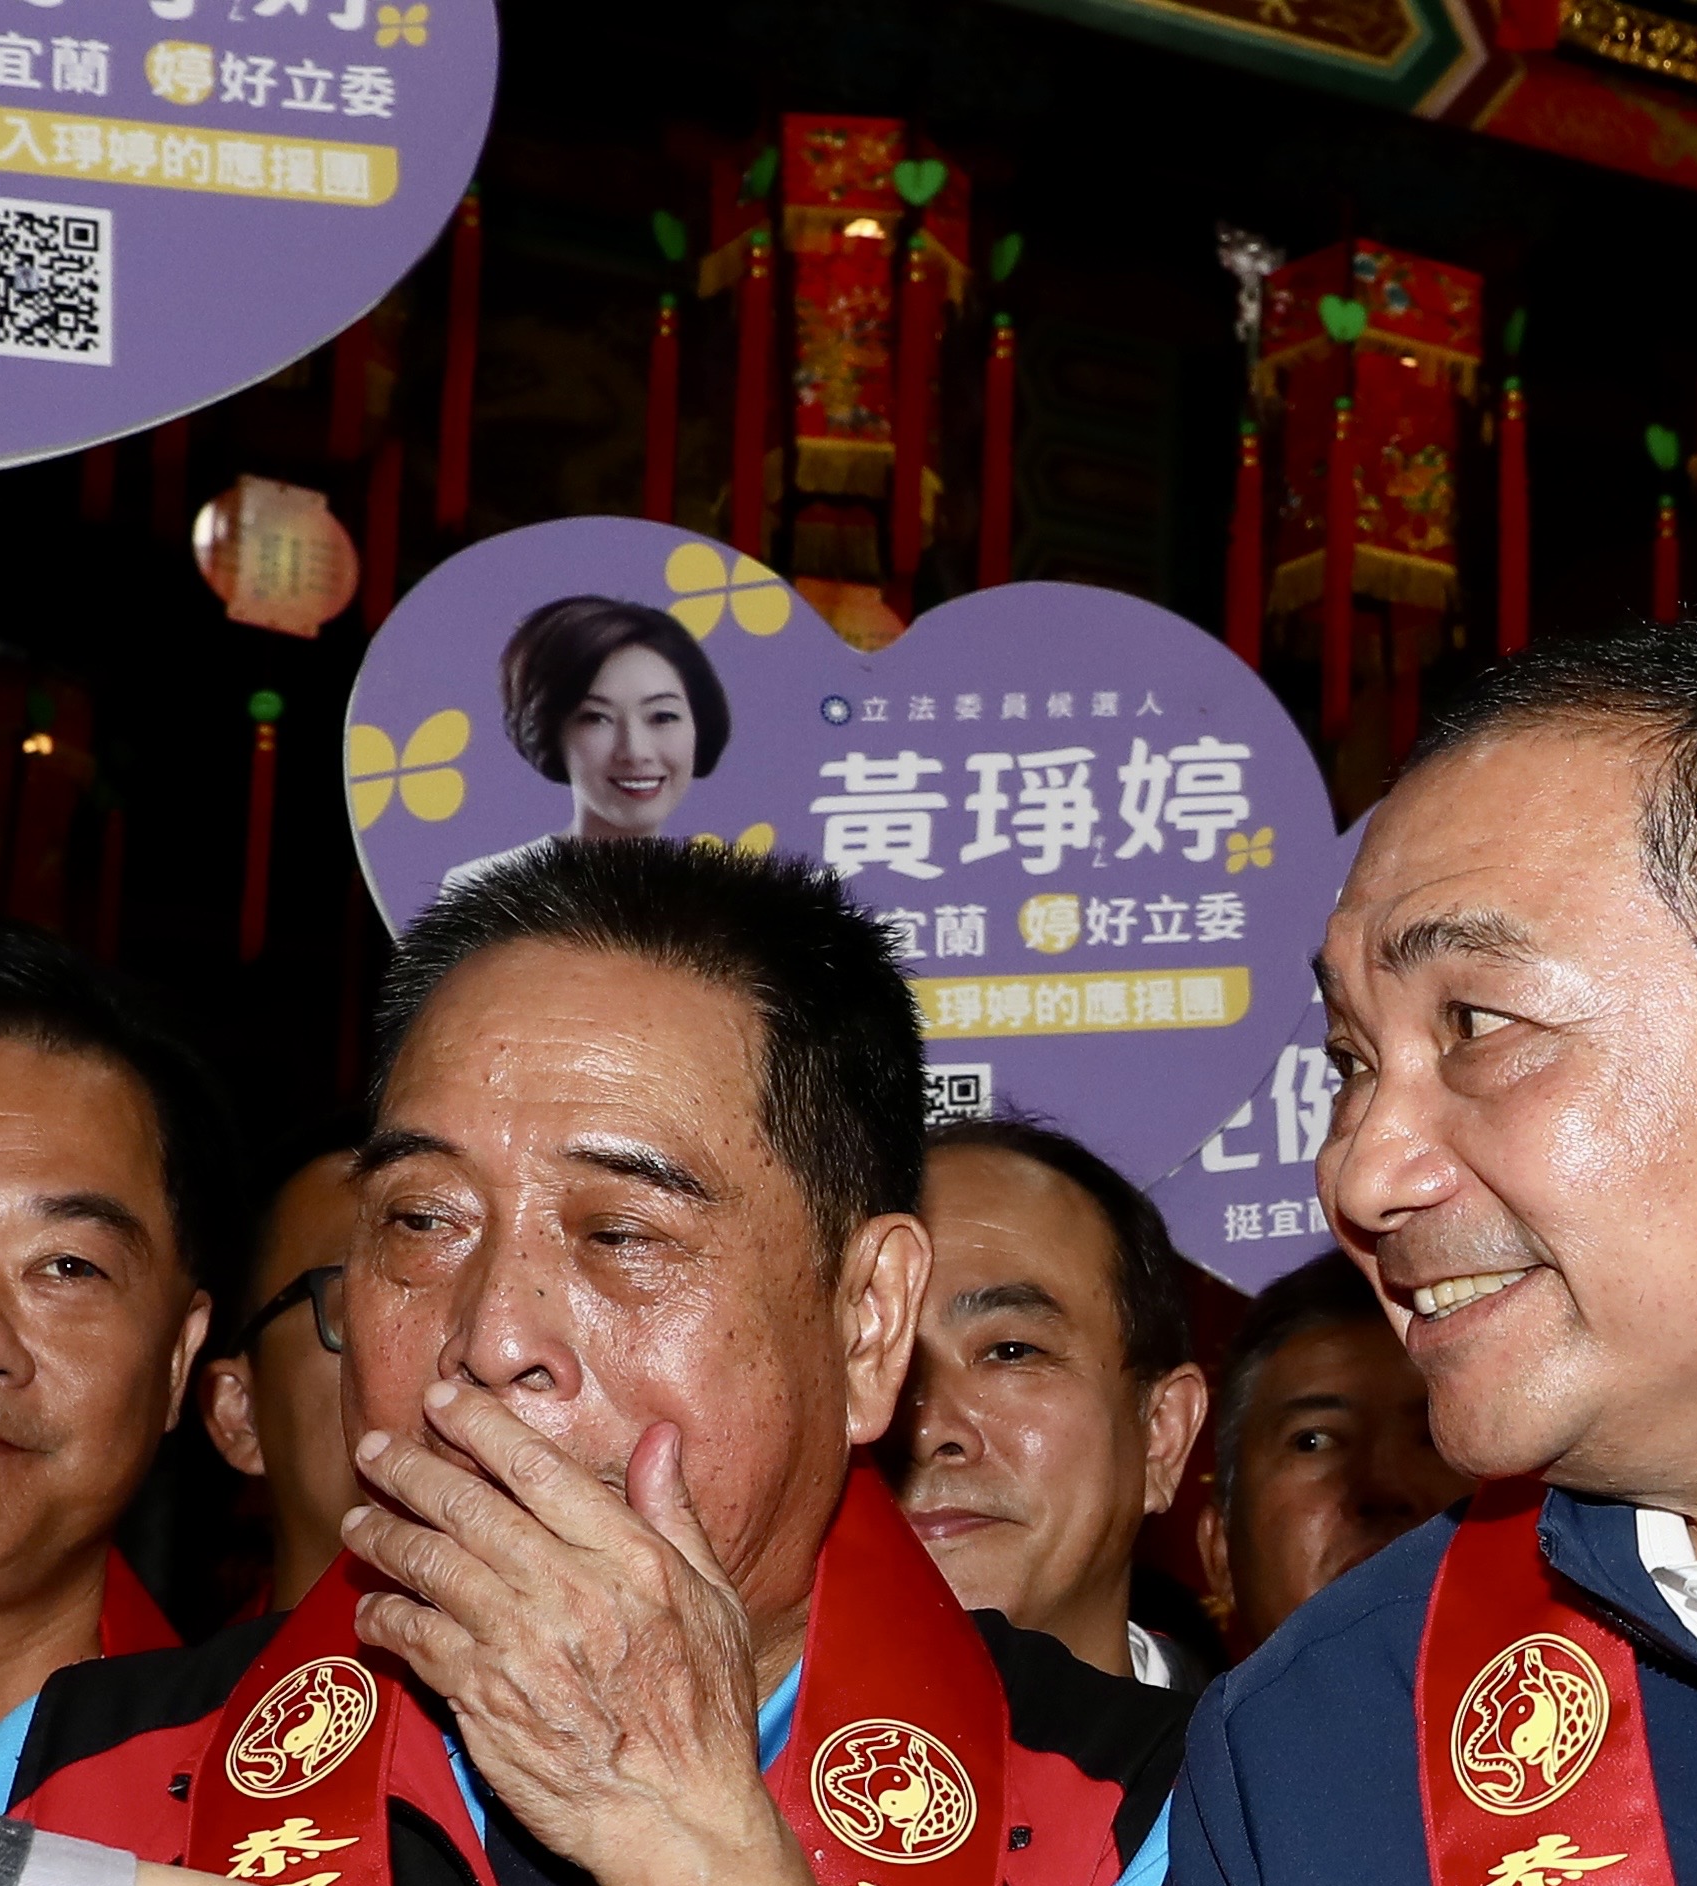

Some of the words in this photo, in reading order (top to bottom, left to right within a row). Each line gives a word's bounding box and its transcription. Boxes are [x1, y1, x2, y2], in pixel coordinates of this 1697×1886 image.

[152, 42, 397, 119] 婷好立委
[860, 690, 1164, 723] 立法委員候選人
[809, 735, 1252, 880] 黃琤婷
[869, 904, 988, 960] 宜蘭
[1023, 892, 1247, 949] 婷好立委
[921, 975, 1226, 1030] 琤婷的應援團
